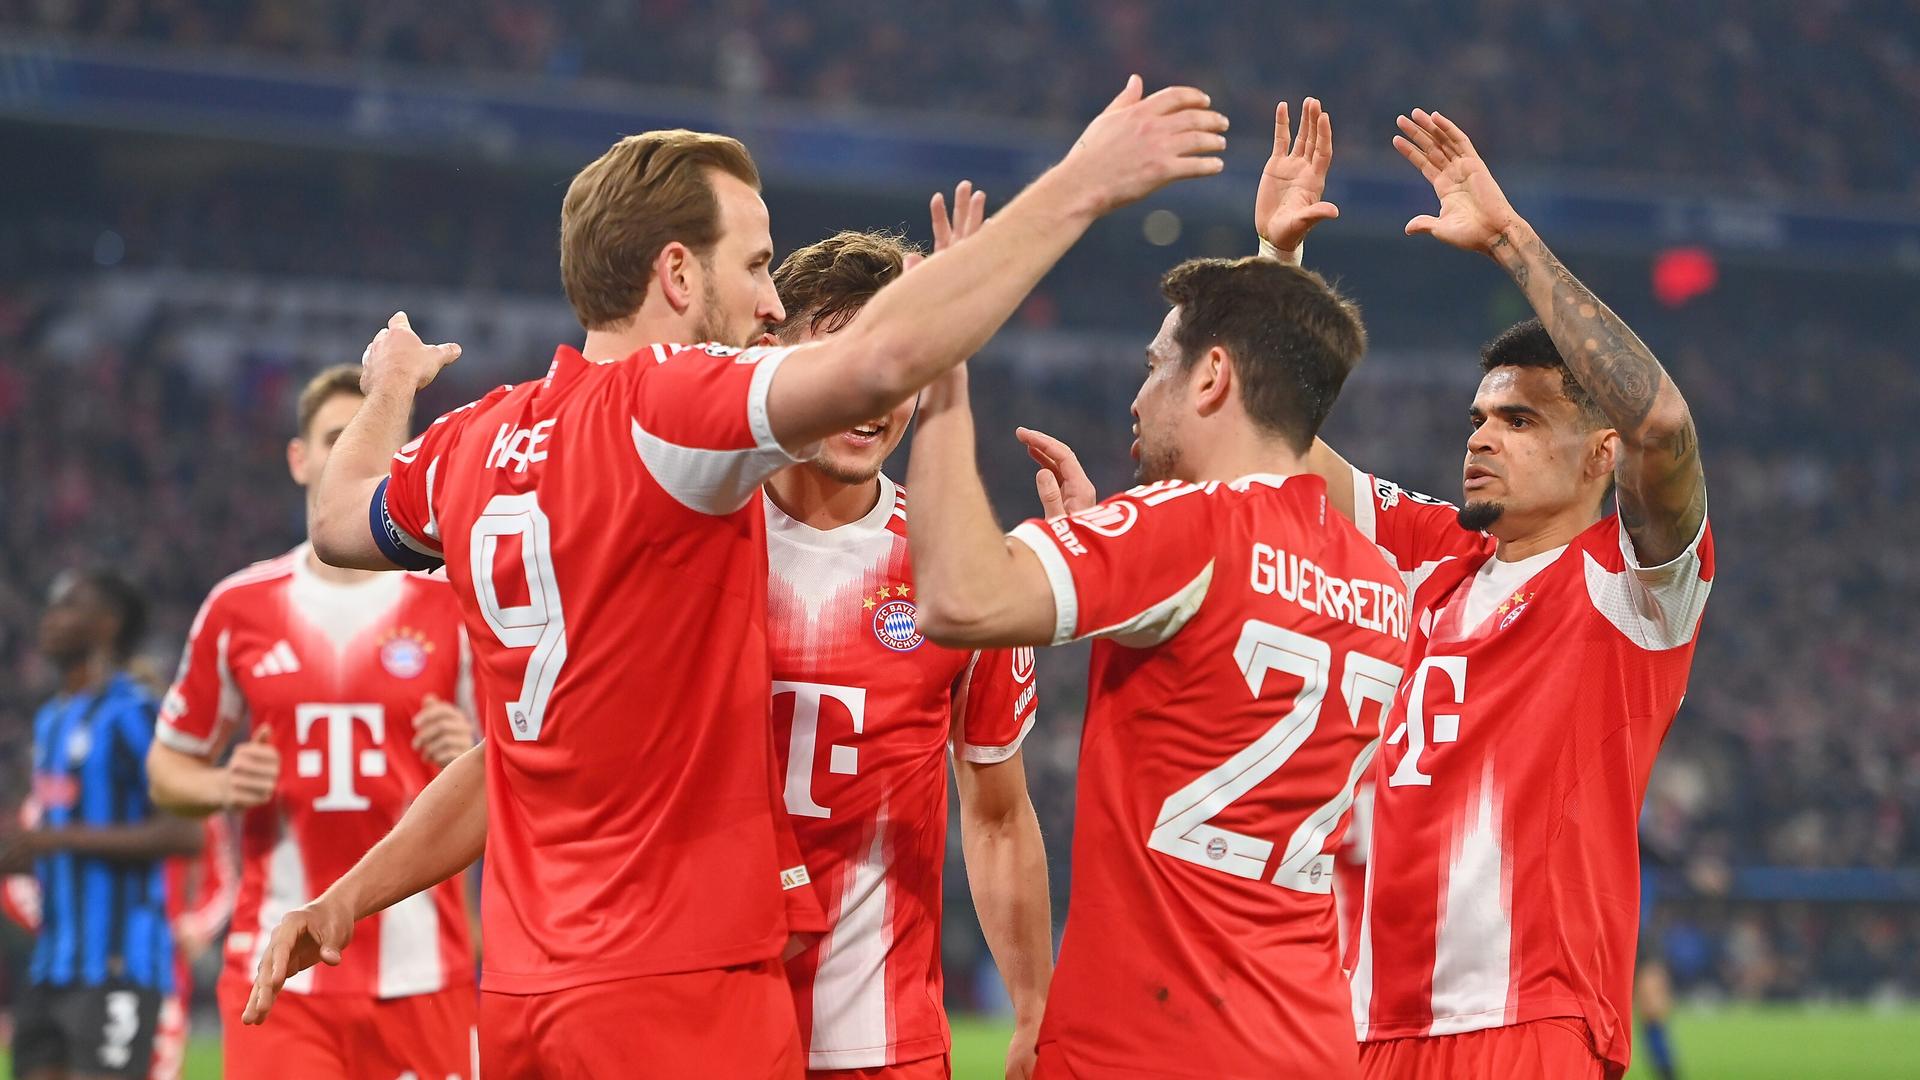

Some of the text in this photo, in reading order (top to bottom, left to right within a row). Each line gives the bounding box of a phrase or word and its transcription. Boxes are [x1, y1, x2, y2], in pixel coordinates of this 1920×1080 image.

[485, 418, 557, 473] KAE
[470, 490, 567, 741] 9
[878, 604, 917, 621] FC BAYER
[295, 703, 386, 812] T
[771, 680, 866, 819] T
[1147, 618, 1404, 894] 22
